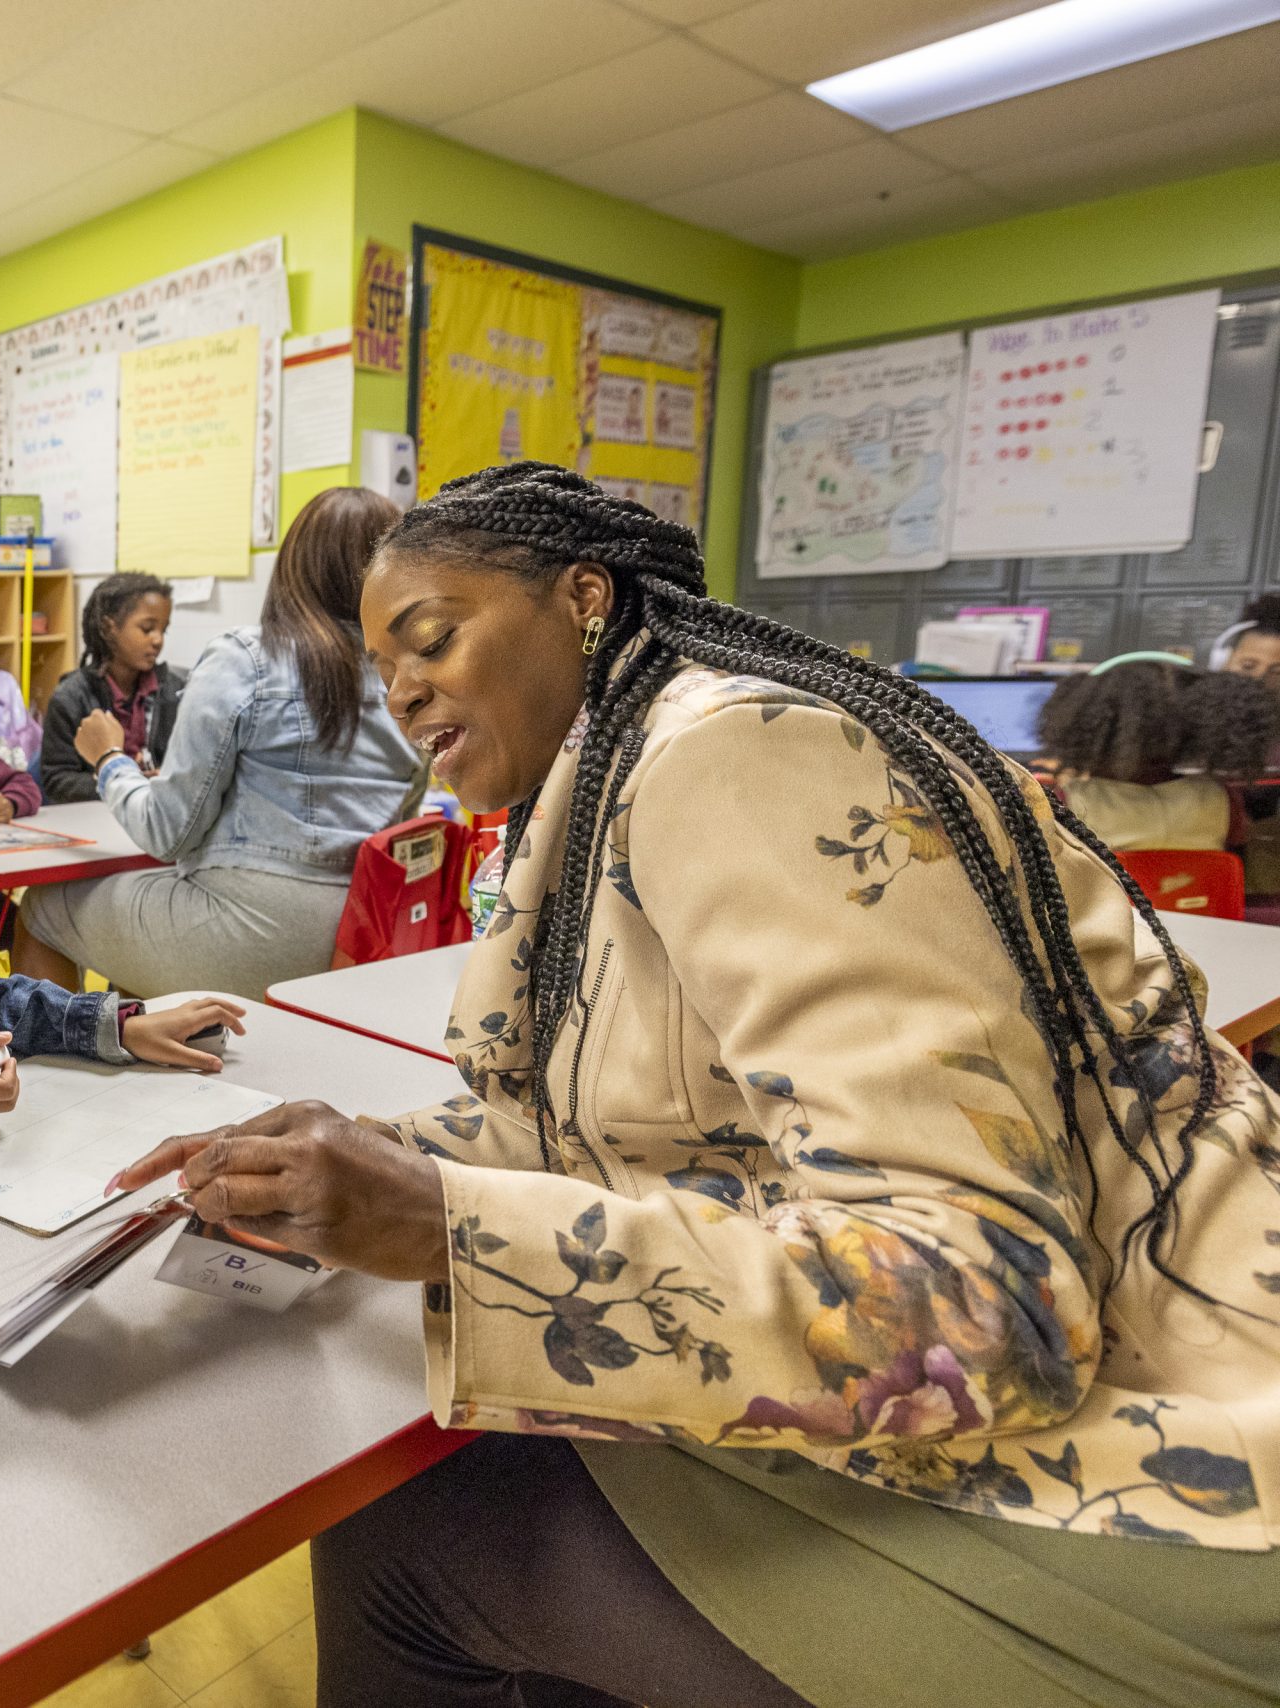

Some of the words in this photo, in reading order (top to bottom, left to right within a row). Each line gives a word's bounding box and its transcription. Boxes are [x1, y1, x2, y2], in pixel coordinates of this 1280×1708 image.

[368, 281, 403, 333] STEP
[356, 331, 403, 371] TIME
[232, 1280, 263, 1294] BIB
